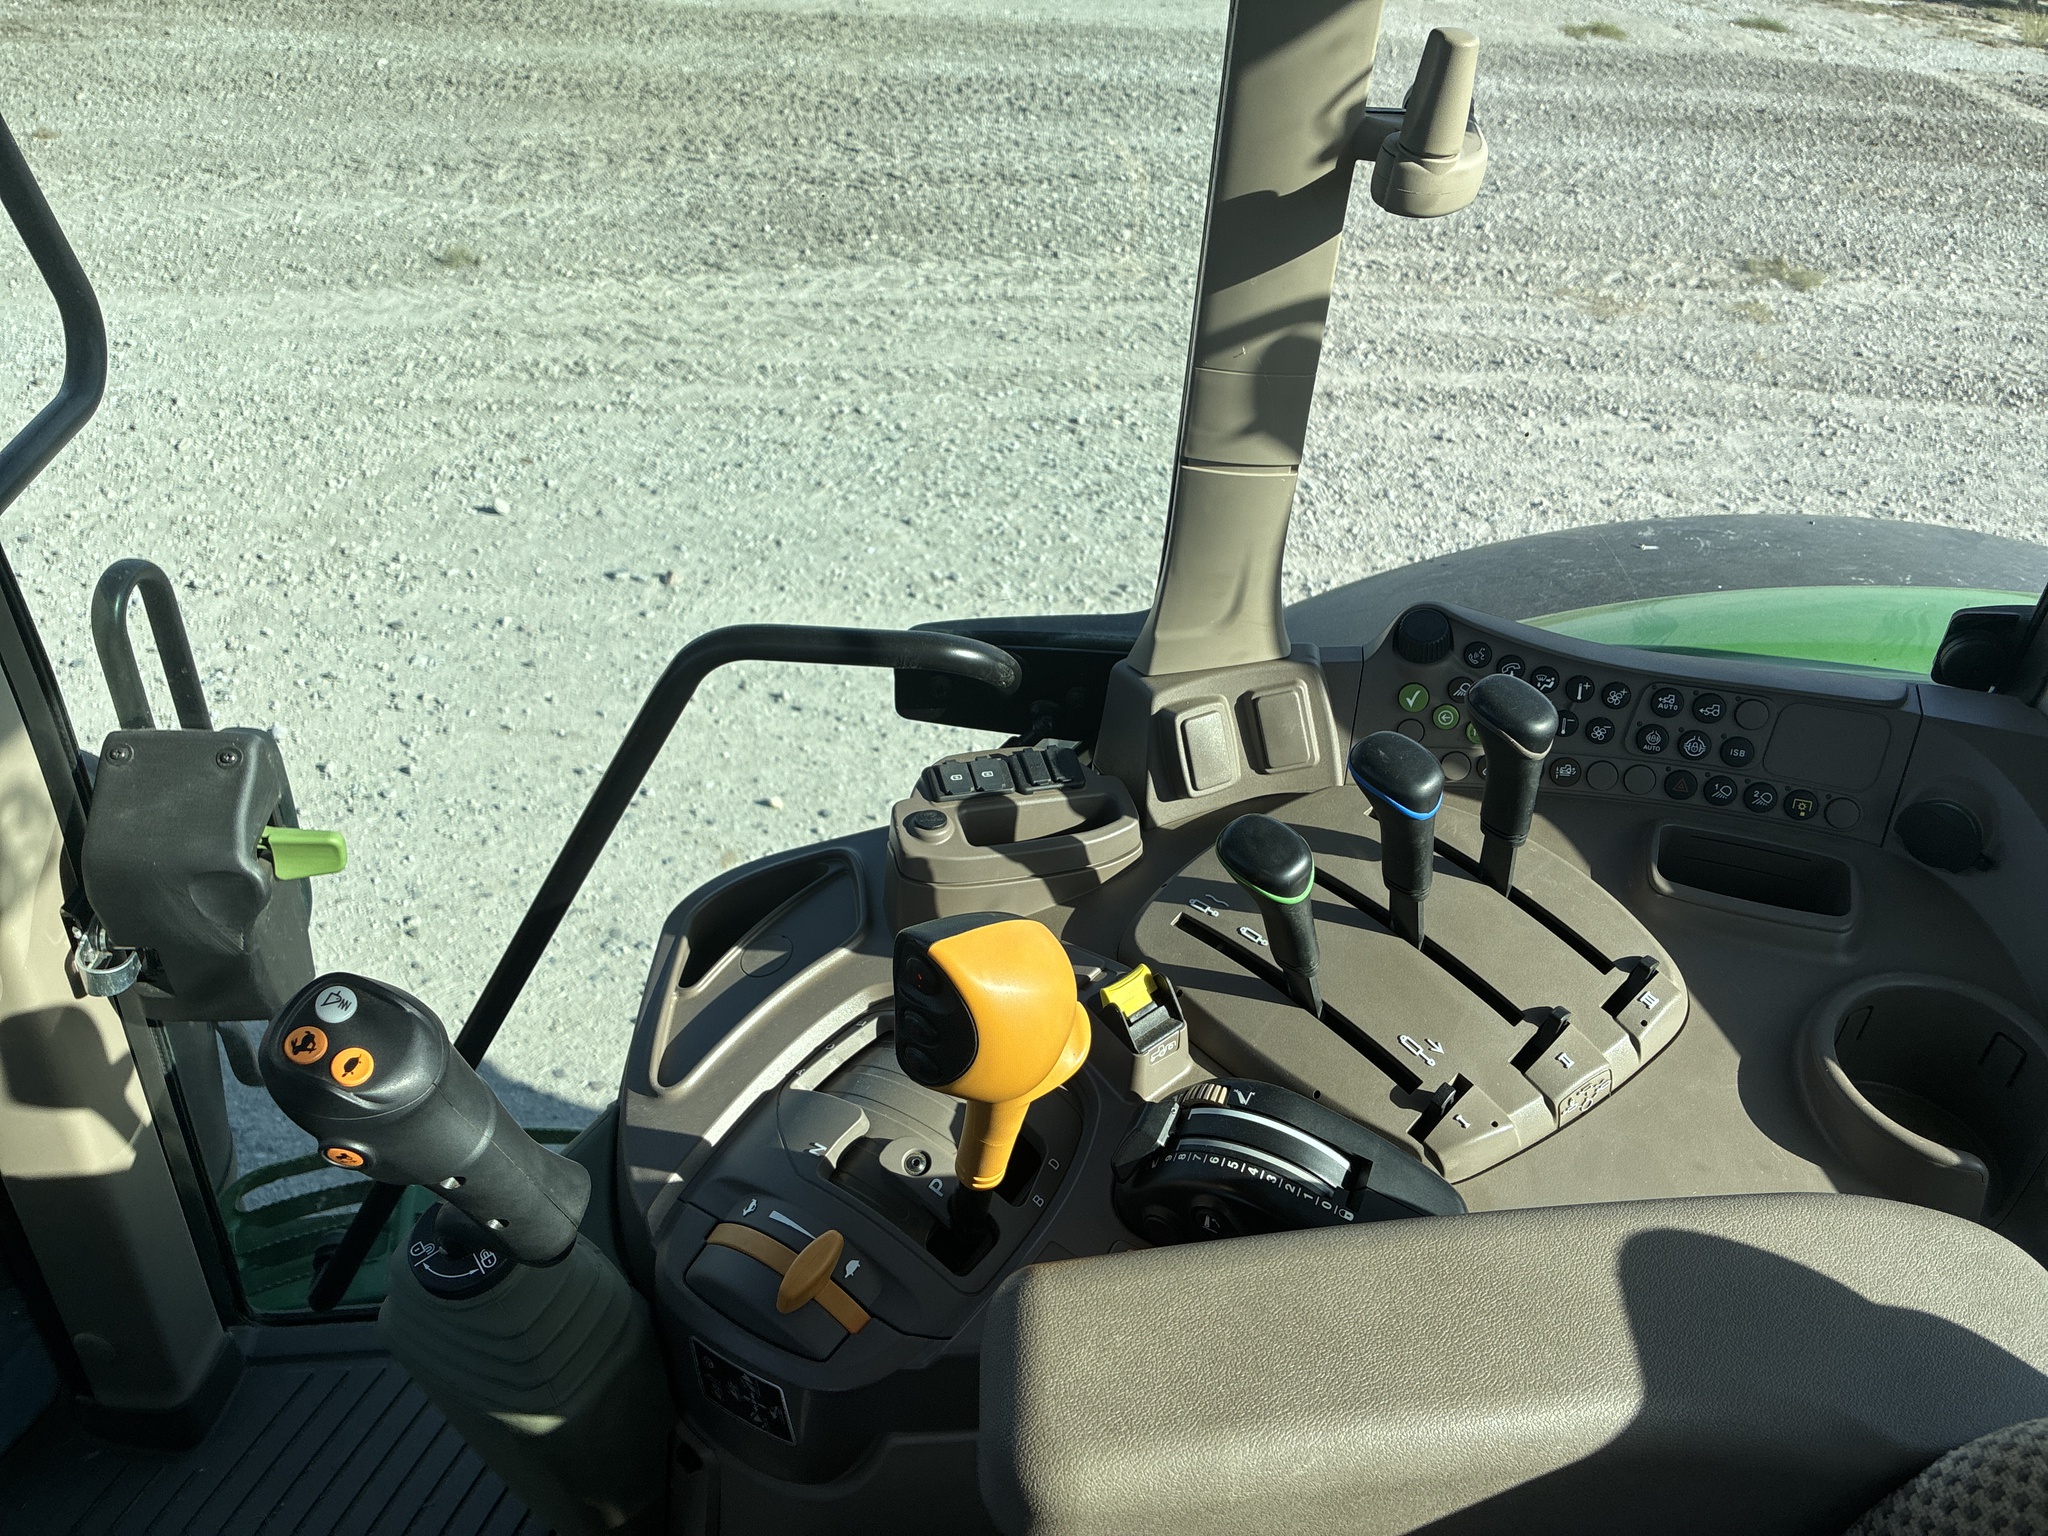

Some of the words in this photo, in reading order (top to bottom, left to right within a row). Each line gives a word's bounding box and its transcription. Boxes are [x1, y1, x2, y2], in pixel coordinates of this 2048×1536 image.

[1657, 703, 1678, 711] AUTO
[1643, 744, 1661, 752] AUTO
[1729, 748, 1746, 758] ISB
[1753, 790, 1760, 798] 2
[1639, 990, 1660, 1011] III
[1557, 1052, 1575, 1069] II
[1047, 1158, 1060, 1171] D
[928, 1177, 944, 1197] P
[1192, 1153, 1202, 1161] 7
[1209, 1156, 1220, 1164] 6
[1226, 1160, 1239, 1170] 5
[1247, 1166, 1259, 1176] 4
[1266, 1174, 1277, 1184] 3
[1284, 1183, 1296, 1193] 2
[1303, 1192, 1314, 1200] 1
[1321, 1200, 1332, 1210] 0
[1032, 1194, 1045, 1208] B
